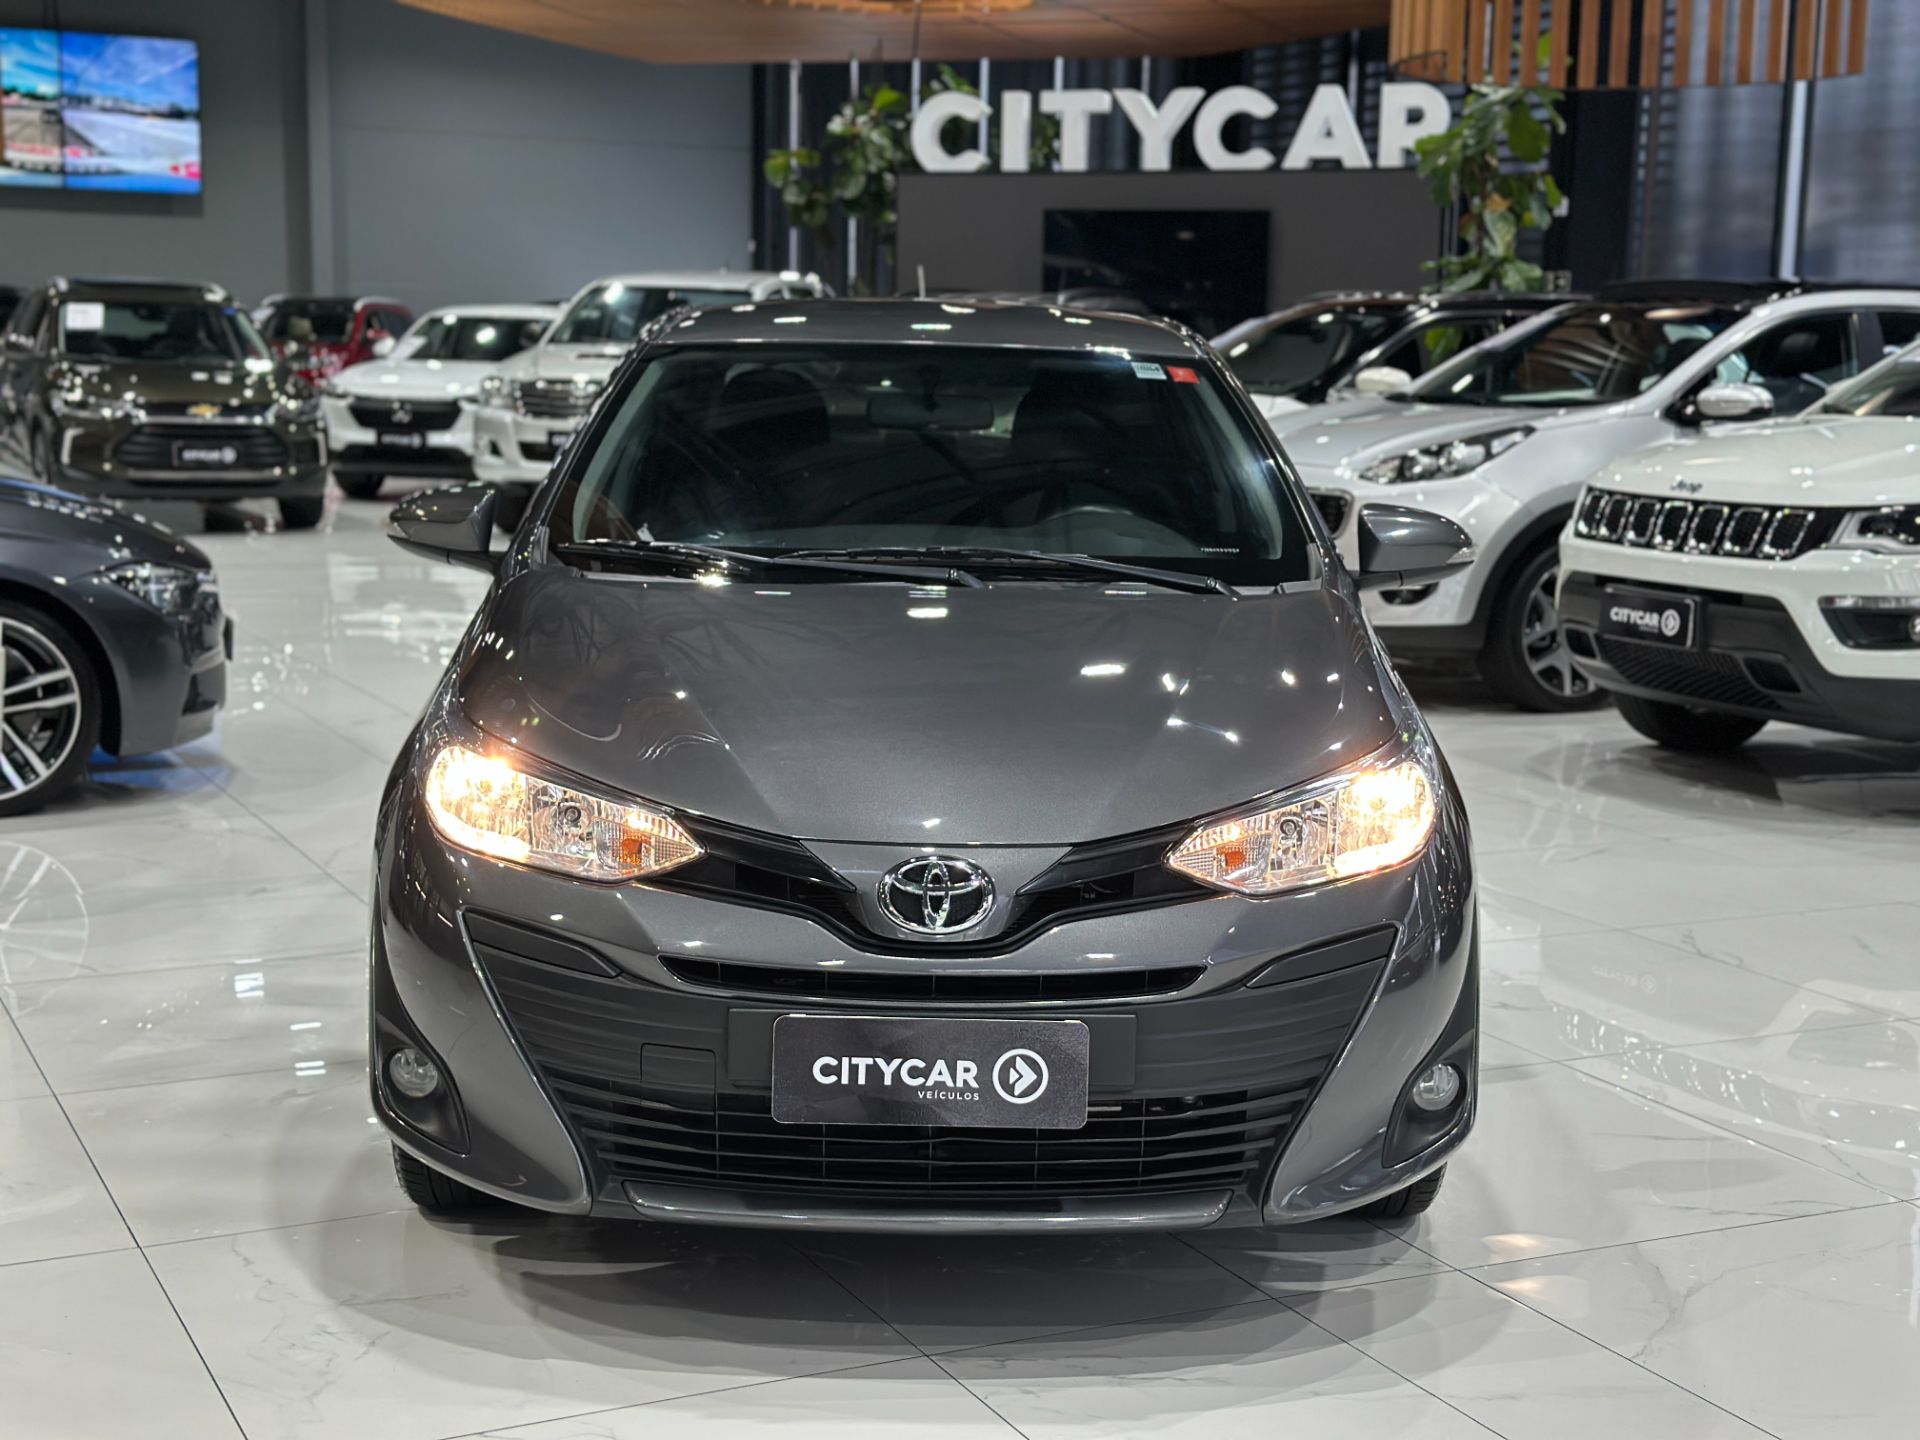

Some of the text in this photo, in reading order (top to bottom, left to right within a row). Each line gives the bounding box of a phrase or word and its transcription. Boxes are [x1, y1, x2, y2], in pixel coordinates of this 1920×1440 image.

[910, 83, 1452, 172] CITYCAR
[1610, 606, 1660, 628] CITYCAR
[812, 1056, 979, 1089] CITYCAR
[918, 1089, 979, 1101] VEÍCULOS
